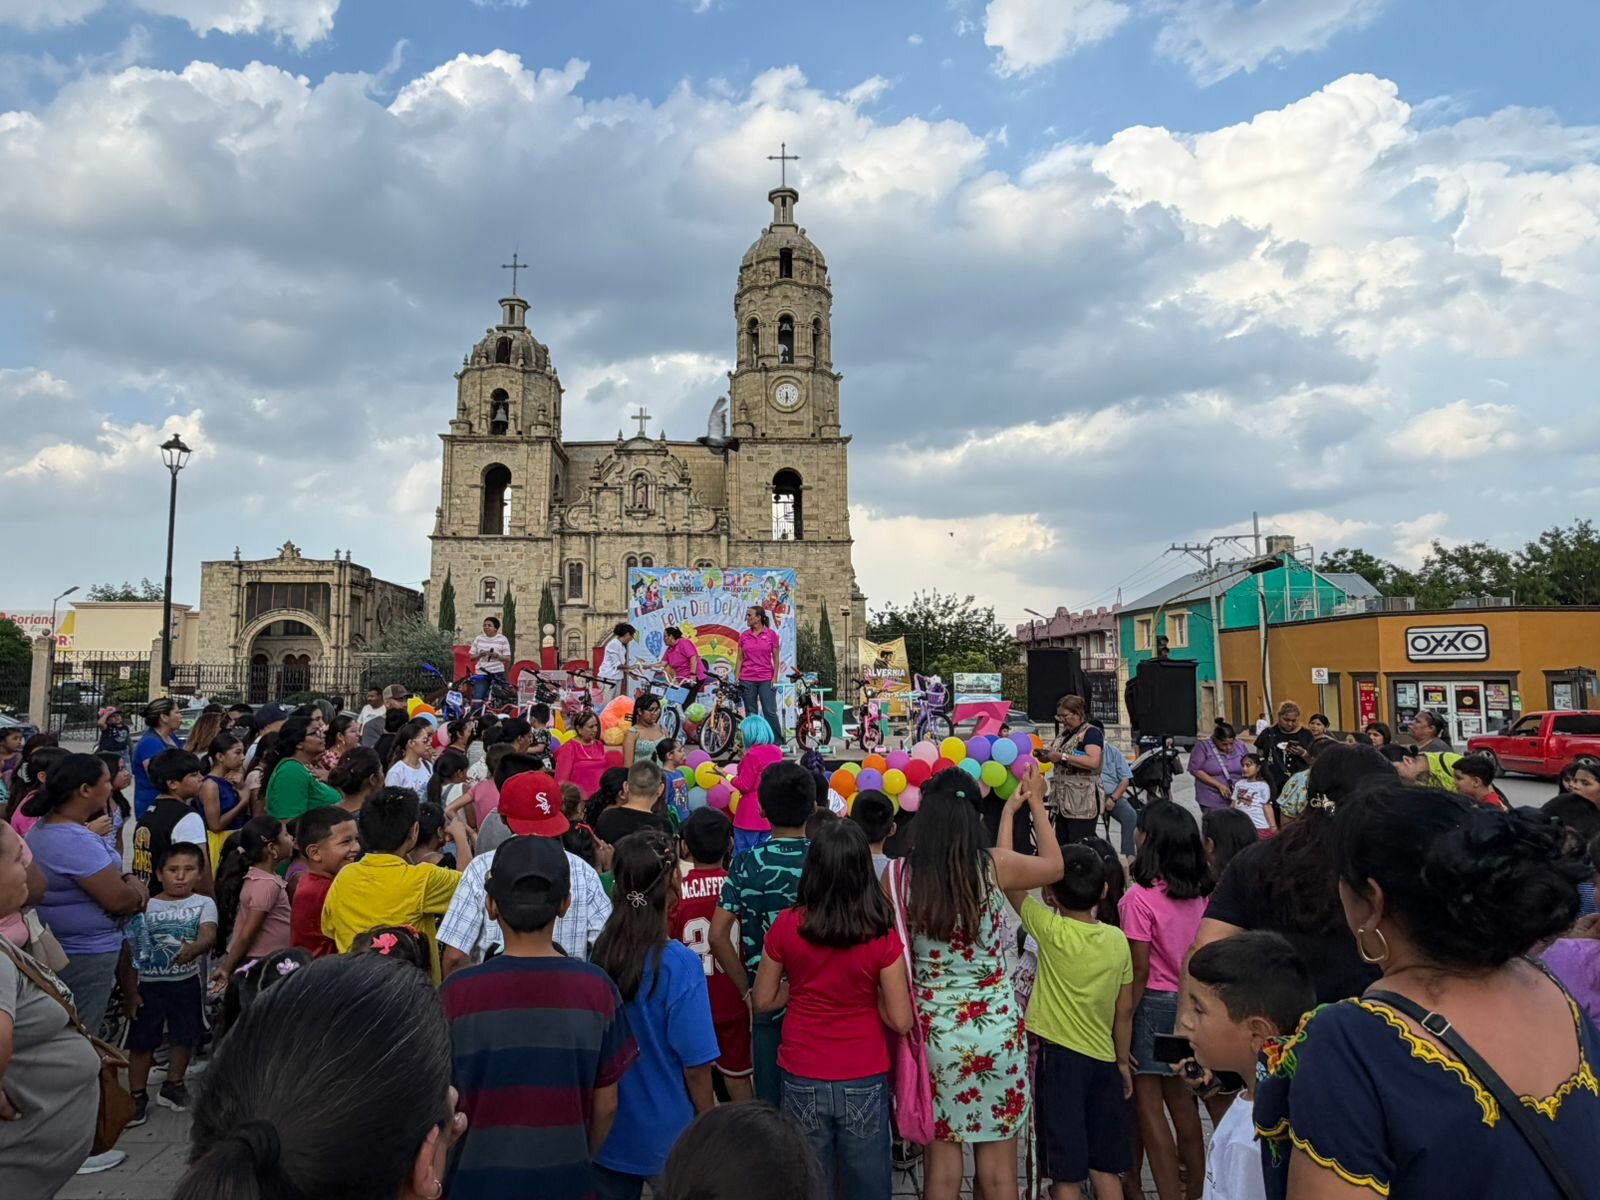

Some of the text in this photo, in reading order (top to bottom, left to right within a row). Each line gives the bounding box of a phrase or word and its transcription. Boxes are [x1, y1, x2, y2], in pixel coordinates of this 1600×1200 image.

[661, 605, 689, 627] Feliz
[714, 597, 732, 616] Del
[1411, 630, 1483, 655] OXXO
[681, 876, 729, 900] McCAFFR
